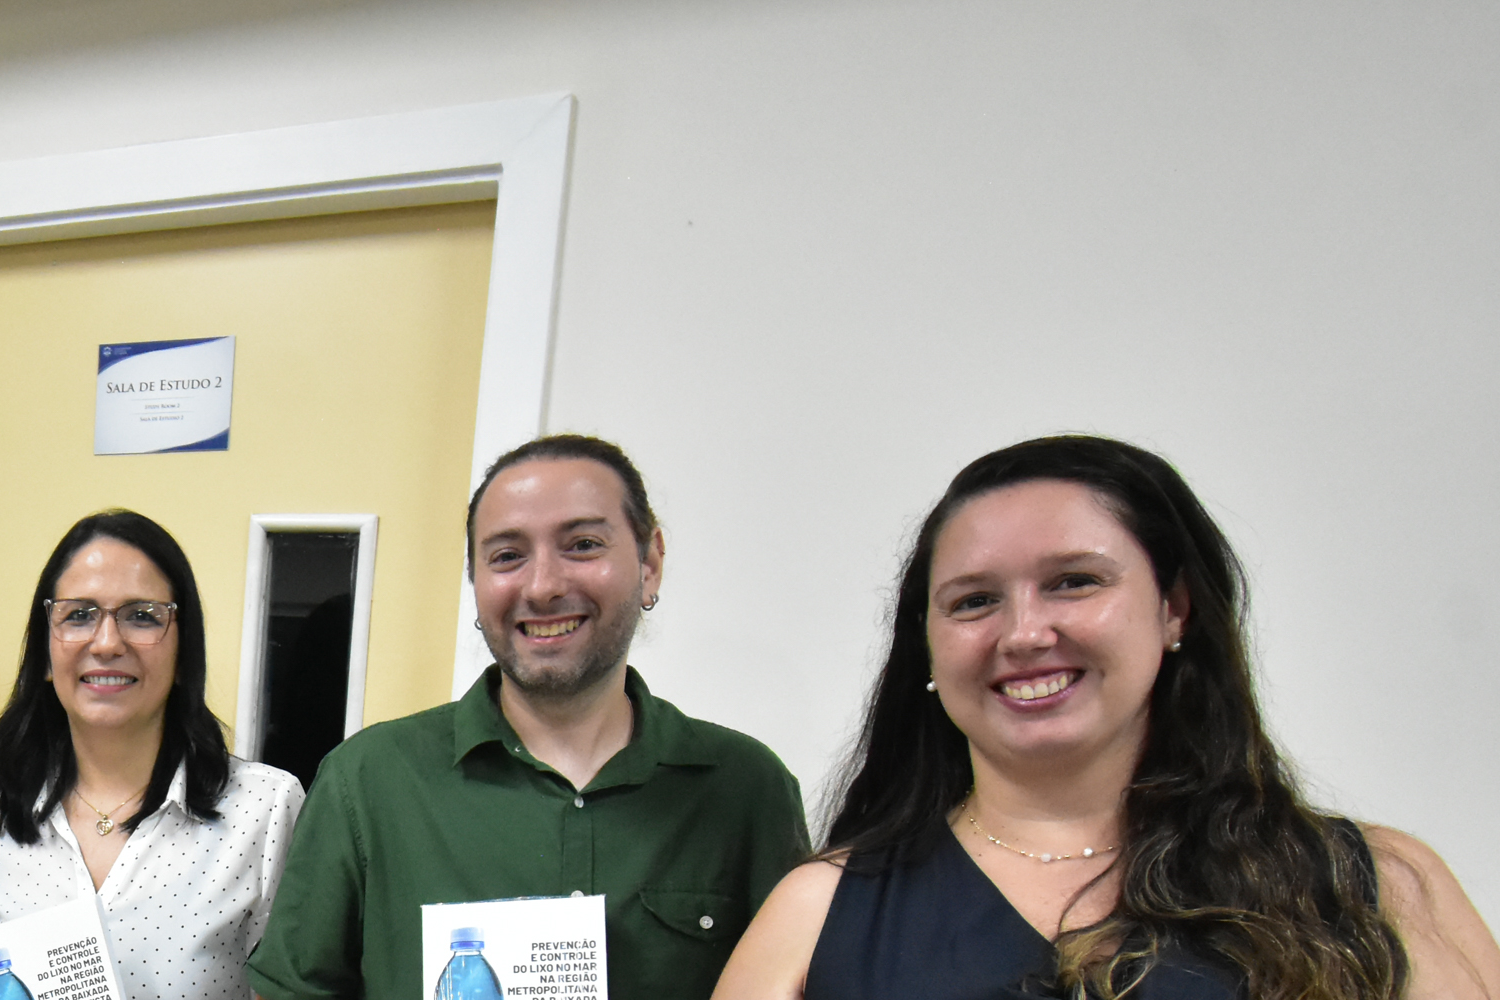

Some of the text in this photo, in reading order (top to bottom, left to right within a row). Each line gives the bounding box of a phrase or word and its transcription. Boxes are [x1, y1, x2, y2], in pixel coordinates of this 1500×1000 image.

[106, 376, 222, 393] SALA DE ESTUDO 2
[47, 937, 97, 958] PREVENÇÃO
[56, 946, 100, 965] CONTROLE
[540, 952, 596, 961] CONTROLE
[38, 956, 102, 981] DO LIXO NO MAR
[60, 965, 105, 984] NA REGIÃO
[513, 963, 597, 973] DO LIXO NO MAR
[540, 972, 597, 983] NA REGIÃO
[38, 975, 107, 1000] METROPOLITANA
[72, 984, 110, 1000] BAIXADA
[508, 985, 597, 995] METROPOLITANA
